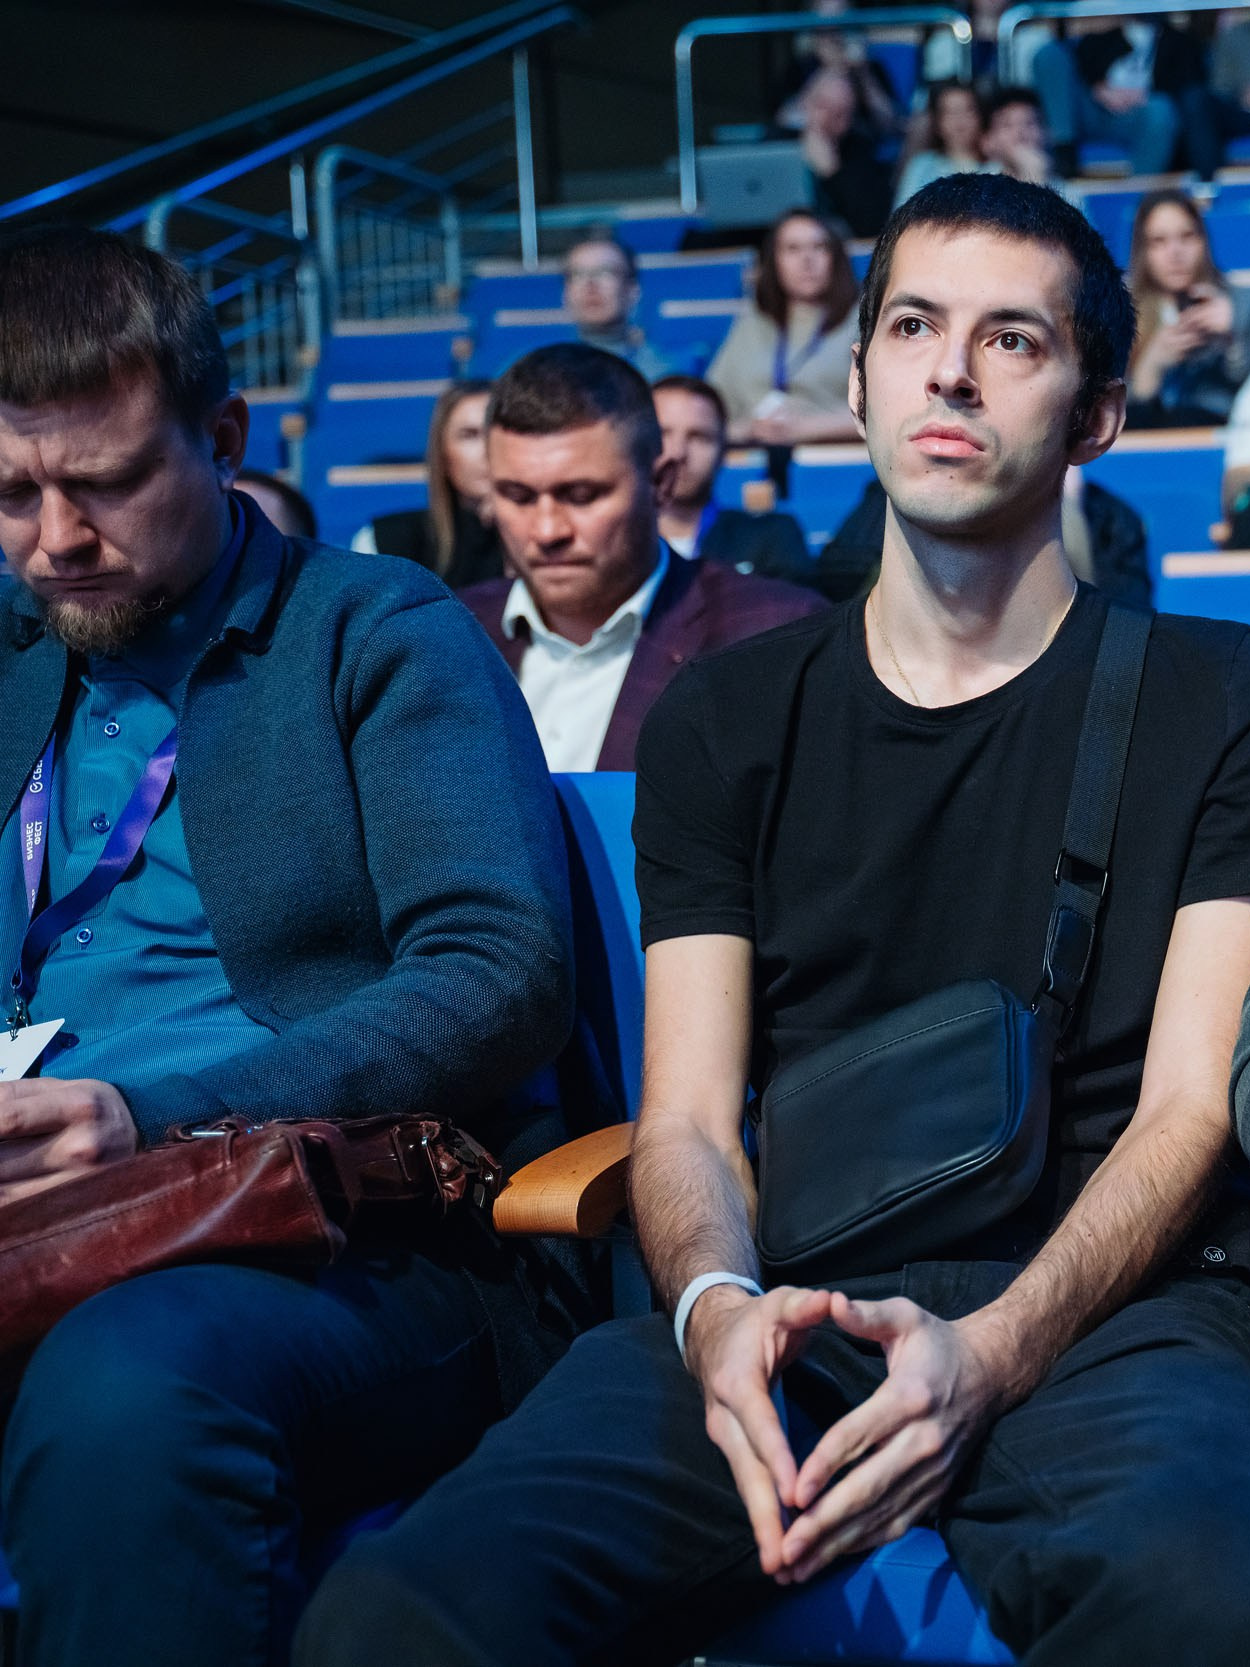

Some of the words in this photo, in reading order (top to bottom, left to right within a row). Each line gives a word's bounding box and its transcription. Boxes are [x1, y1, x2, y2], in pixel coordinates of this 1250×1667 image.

[33, 760, 43, 780] СБЕ
[26, 822, 34, 861] БИЗНЕС
[34, 820, 43, 845] ФЕСТ
